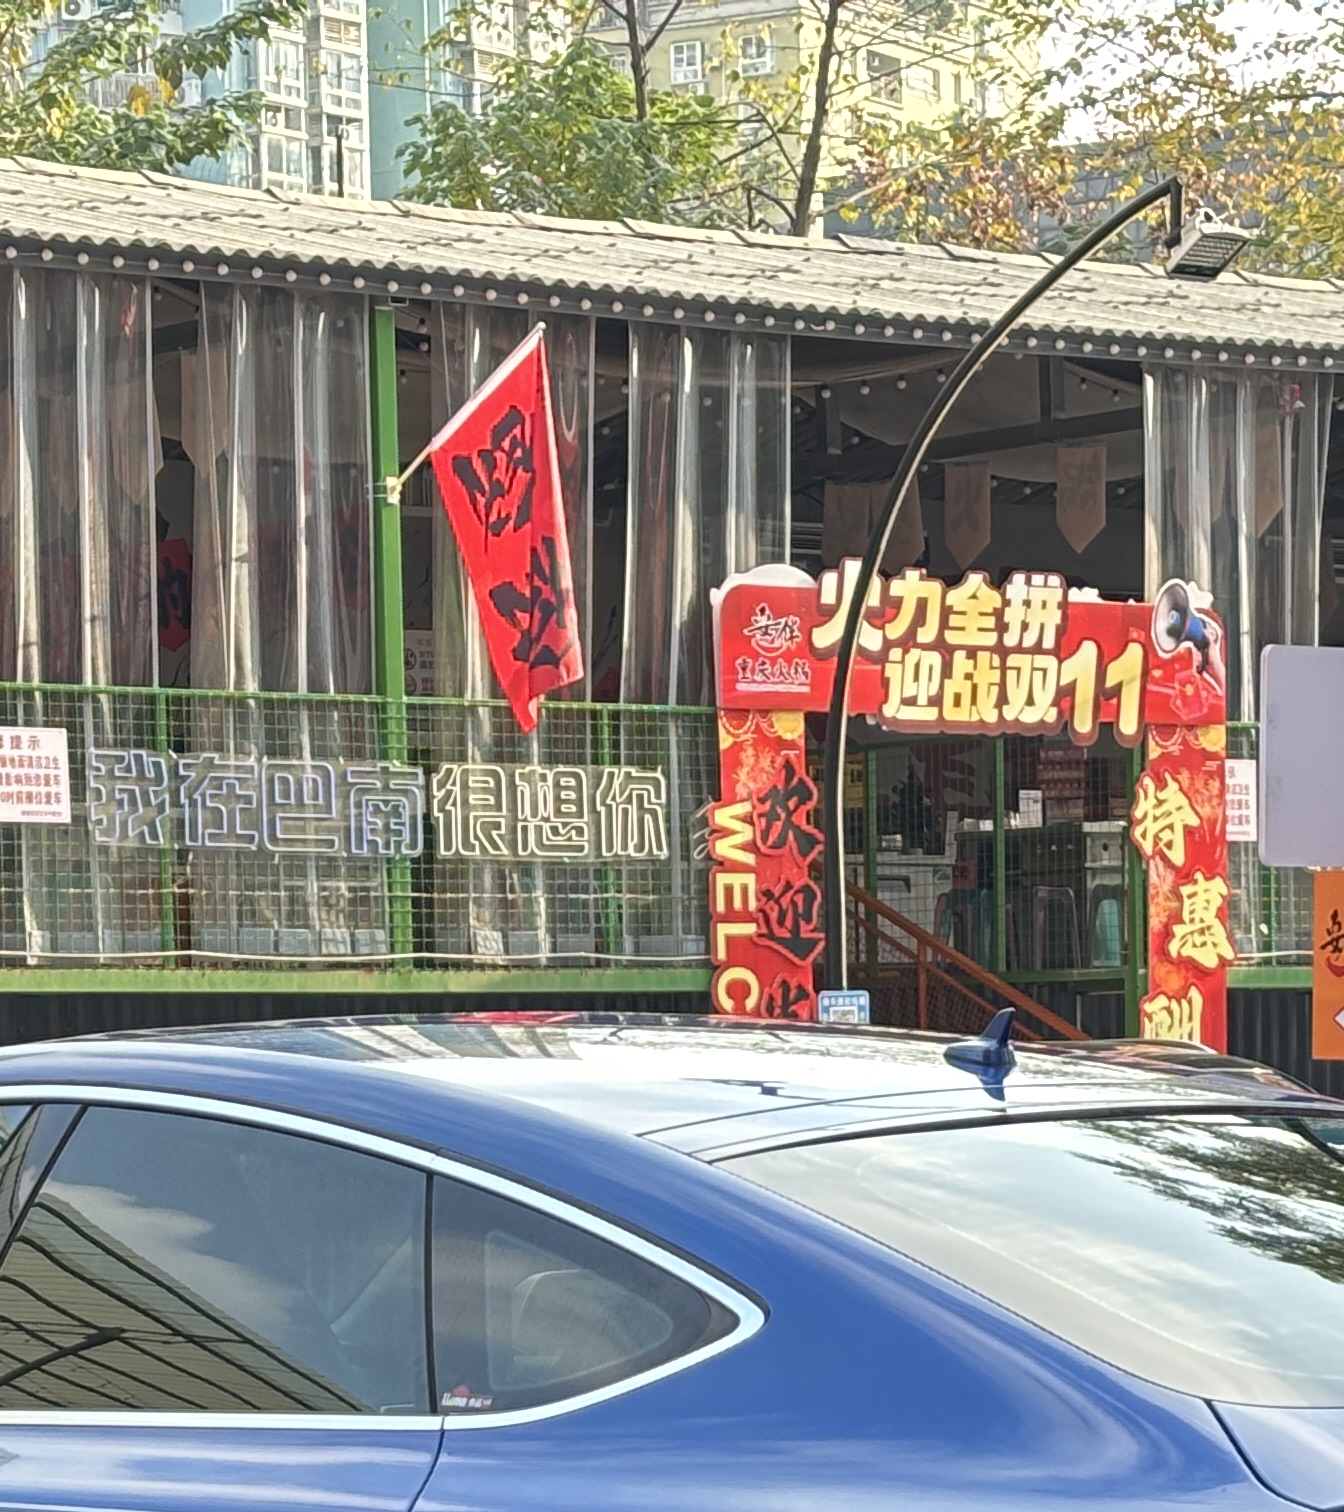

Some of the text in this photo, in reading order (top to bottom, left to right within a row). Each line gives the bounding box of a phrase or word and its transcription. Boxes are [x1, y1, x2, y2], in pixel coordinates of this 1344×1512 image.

[811, 556, 1064, 651] 火力全拼
[882, 647, 1145, 736] 迎战双11
